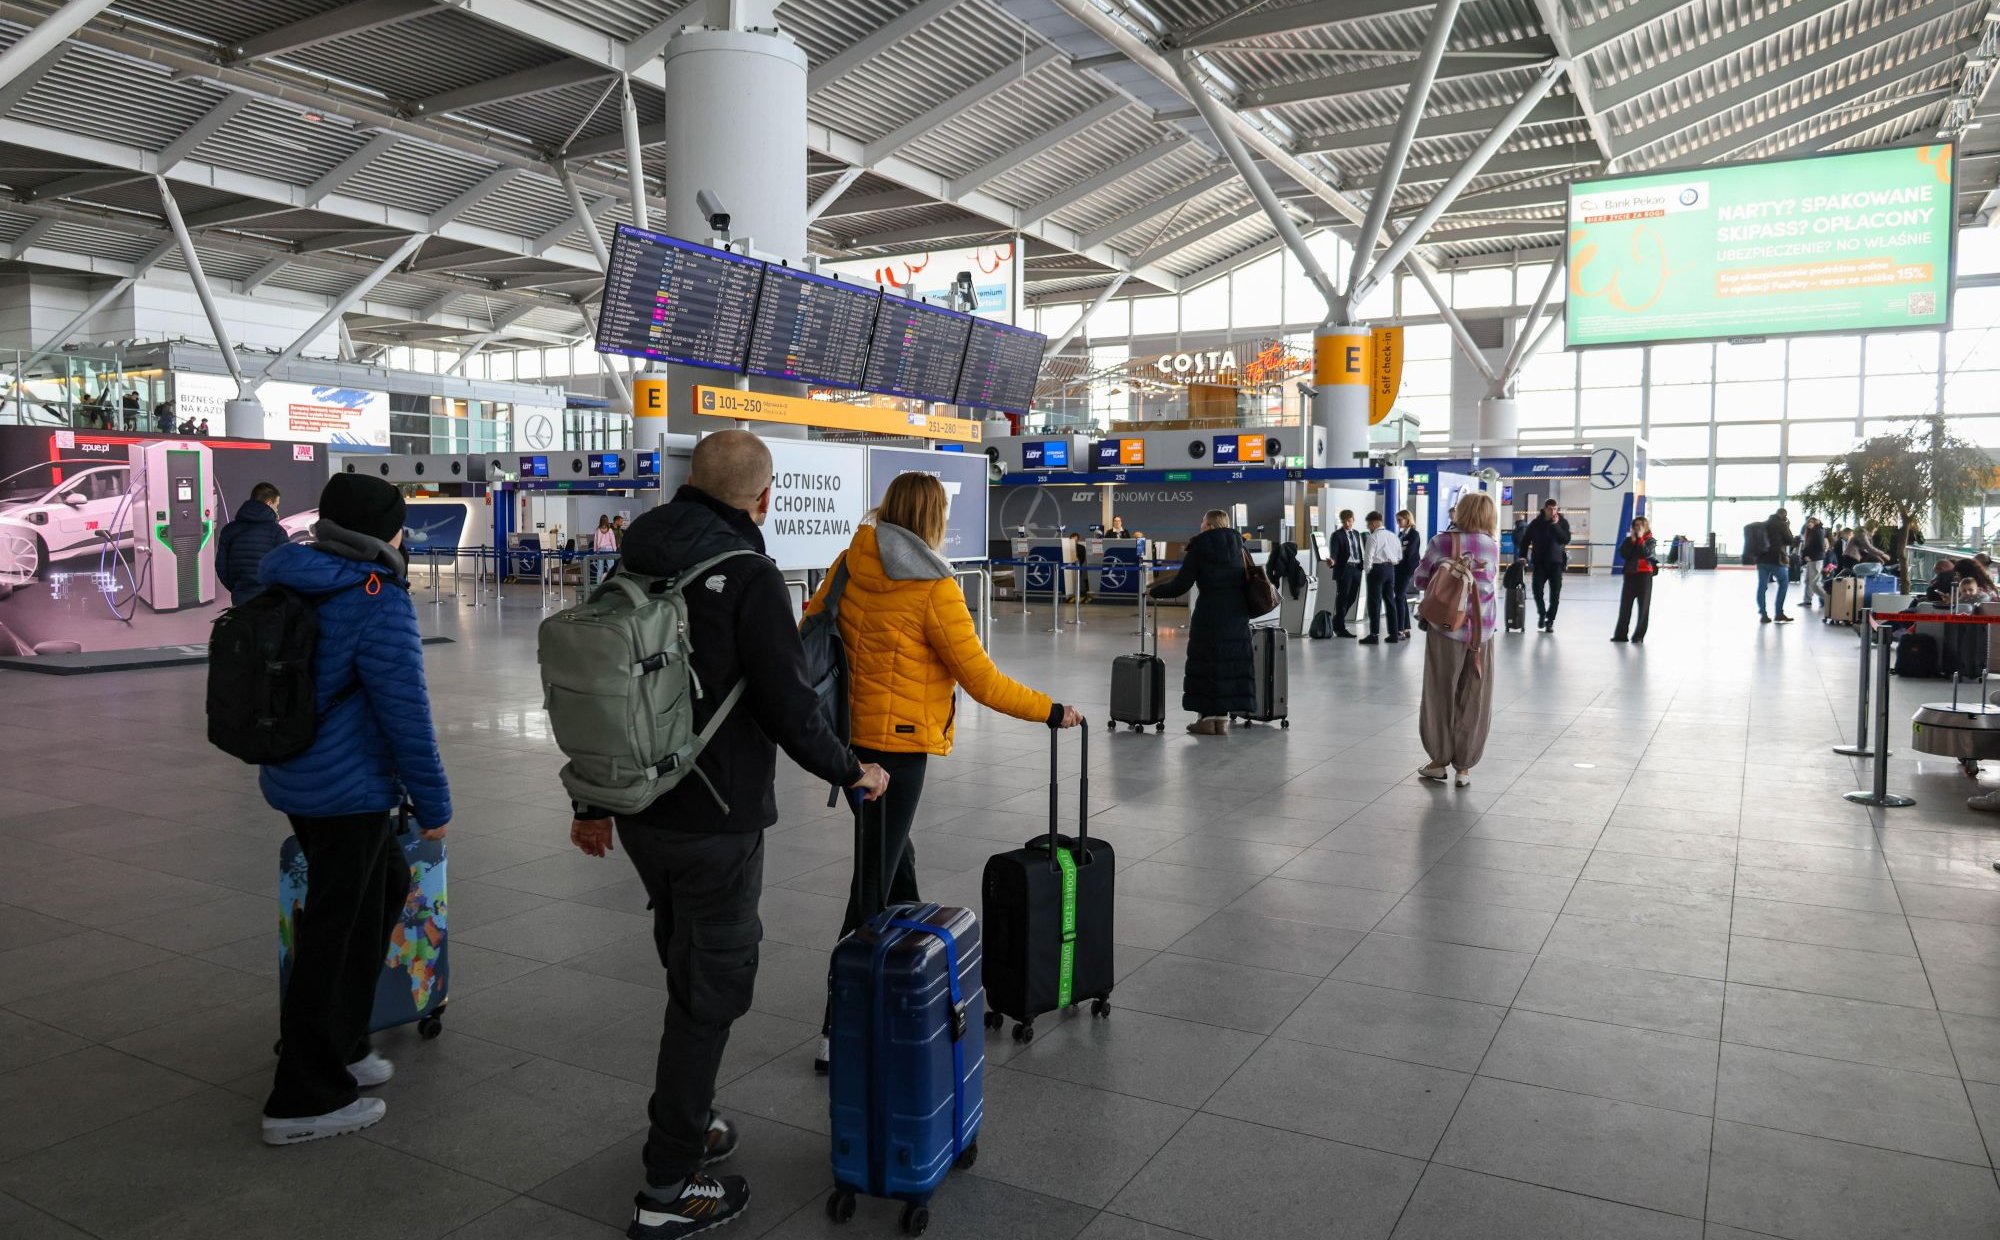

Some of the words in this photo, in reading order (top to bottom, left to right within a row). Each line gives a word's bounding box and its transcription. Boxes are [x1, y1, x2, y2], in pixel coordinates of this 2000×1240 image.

[1604, 198, 1630, 210] Bank
[1634, 196, 1666, 206] Pekao
[1718, 198, 1796, 221] NARTY?
[1801, 185, 1933, 214] SPAKOWANE
[1717, 220, 1809, 242] SKIPASS?
[1812, 208, 1934, 234] OPŁACONY
[1716, 241, 1833, 262] UBEZPIECZENIE?
[1837, 238, 1860, 250] NO
[1865, 230, 1933, 248] WŁAŚNIE
[974, 289, 1002, 298] remium
[1346, 346, 1360, 372] E
[1382, 332, 1392, 374] check-in
[1158, 350, 1237, 374] COSTA
[1178, 376, 1216, 384] COFFEE
[1382, 376, 1391, 394] Self
[180, 394, 215, 404] BIZNES
[648, 388, 660, 408] E
[719, 396, 762, 413] 101–250
[928, 420, 957, 434] 251–280
[81, 444, 110, 453] zpue.pl
[1101, 449, 1117, 457] LOT
[1217, 445, 1235, 453] LOT
[776, 472, 840, 491] LOTNISKO
[775, 496, 835, 513] CHOPINA
[1072, 492, 1095, 502] LOT
[1099, 492, 1155, 502] EONOMY
[1157, 492, 1193, 502] CLASS
[775, 519, 850, 535] WARSZAWA
[1062, 946, 1071, 979] OWNER
